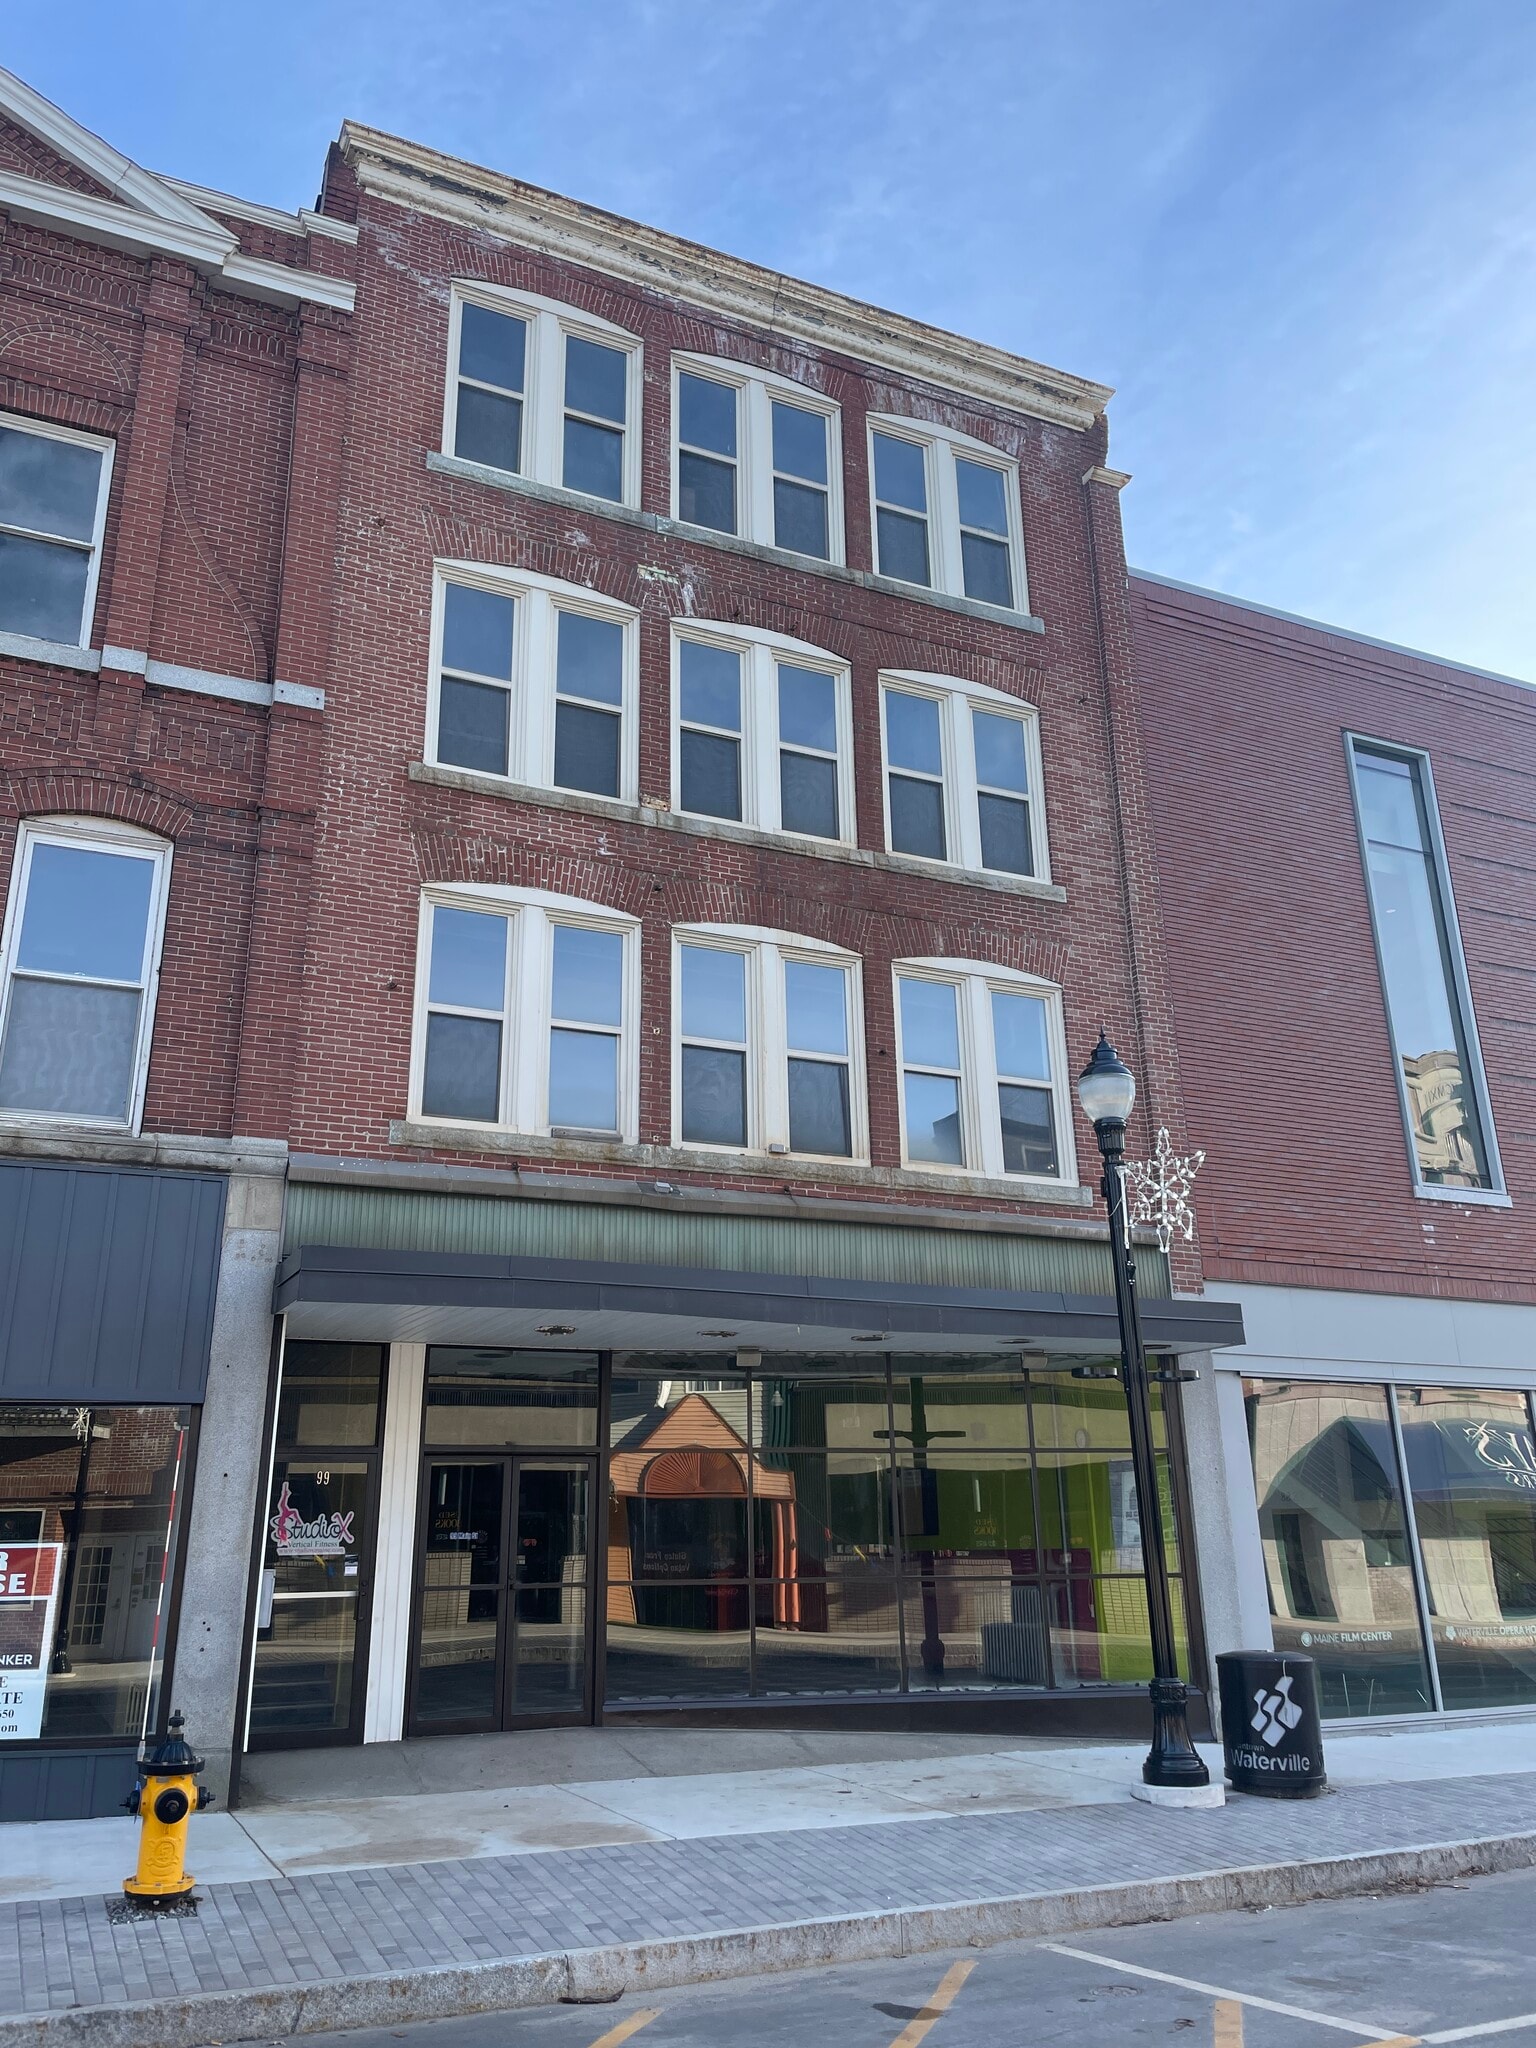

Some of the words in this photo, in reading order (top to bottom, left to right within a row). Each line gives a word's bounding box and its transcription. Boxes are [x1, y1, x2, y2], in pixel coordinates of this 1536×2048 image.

[316, 1470, 330, 1485] 99
[288, 1540, 313, 1548] Vertical
[314, 1540, 338, 1548] Fitness
[1313, 1633, 1340, 1644] MAINE
[1341, 1632, 1360, 1642] FILM
[1361, 1631, 1393, 1641] CENTER
[1457, 1627, 1498, 1637] WATERVILLE
[1499, 1625, 1525, 1636] OPERA
[1231, 1749, 1311, 1772] Waterville
